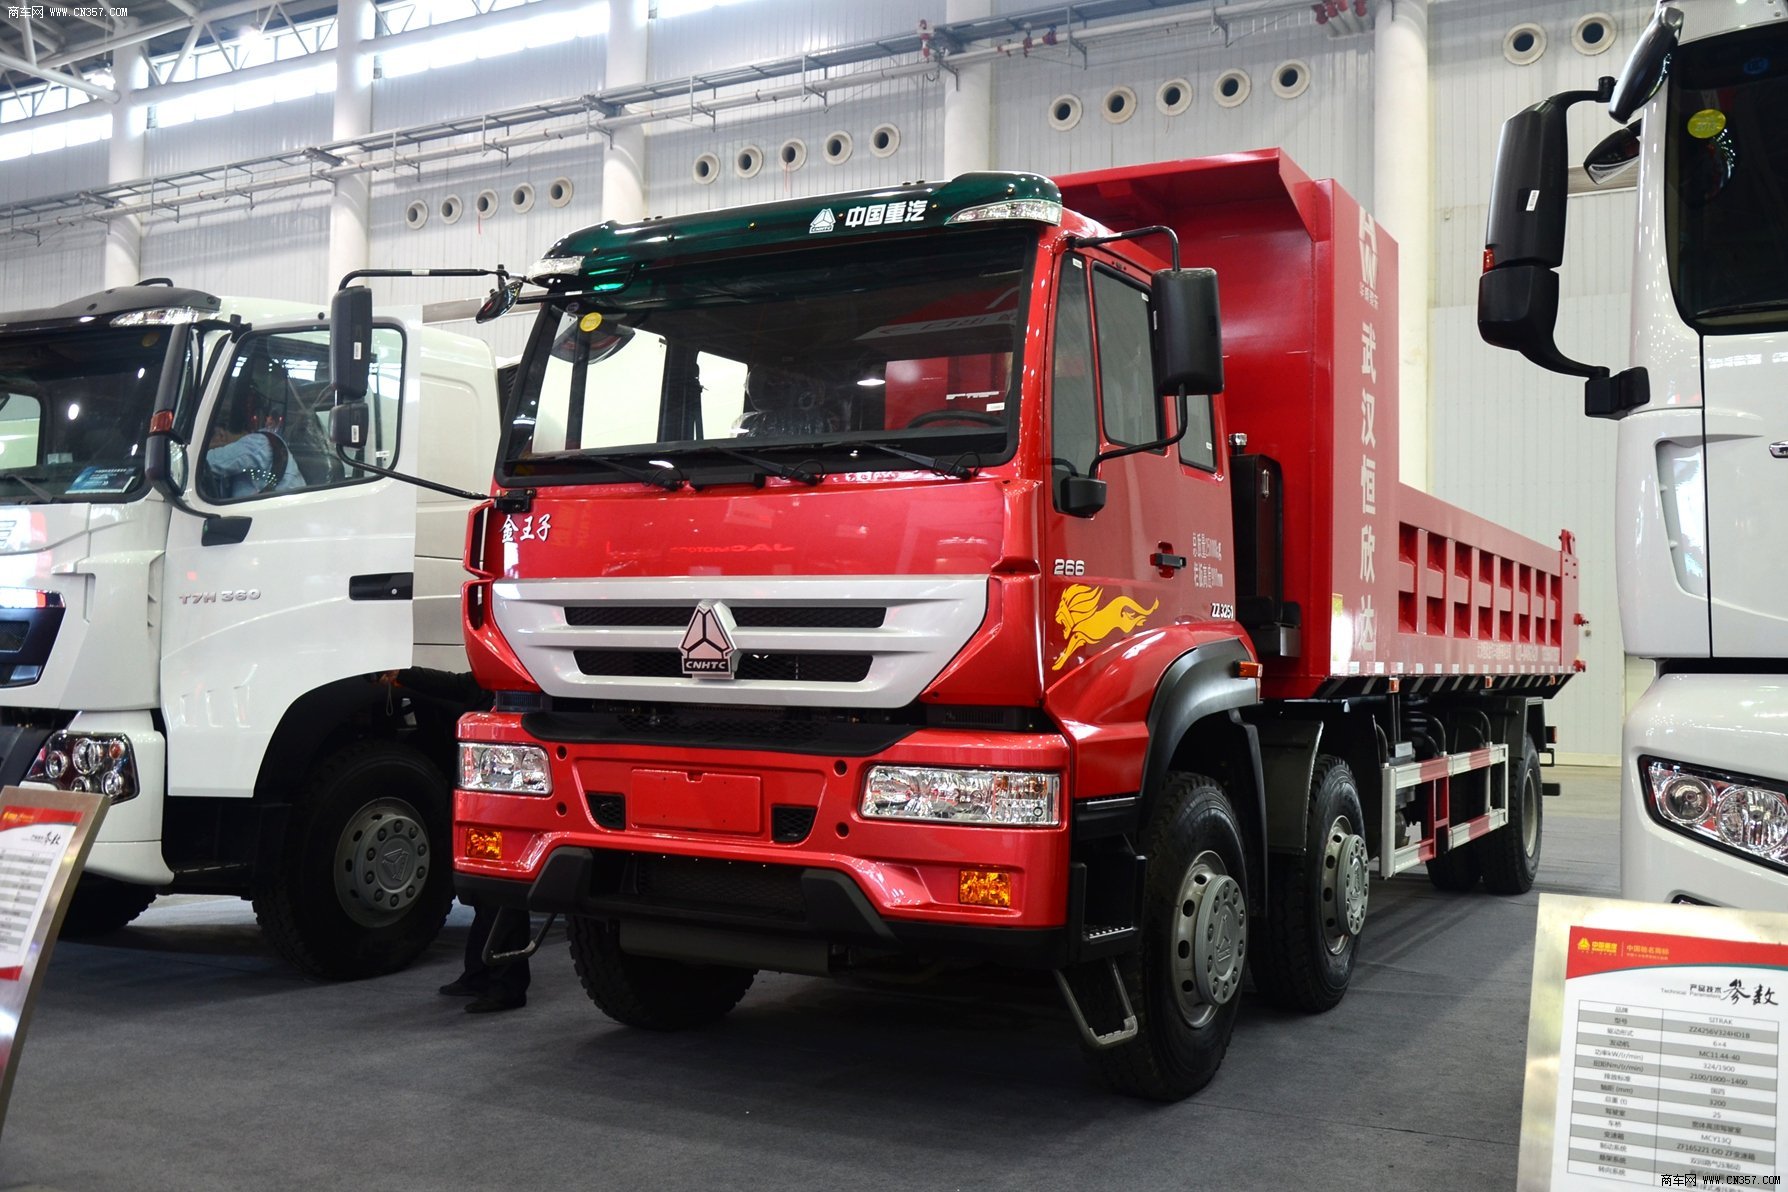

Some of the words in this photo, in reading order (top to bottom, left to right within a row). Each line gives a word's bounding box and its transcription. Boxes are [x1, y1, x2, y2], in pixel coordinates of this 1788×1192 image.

[845, 200, 928, 228] 中国重汽
[1360, 321, 1377, 651] 武汉恒欣达
[500, 513, 552, 543] 金王子
[1054, 558, 1085, 576] 266
[179, 592, 217, 605] T7H
[221, 589, 261, 602] 360
[685, 660, 727, 670] CNHTC
[1689, 983, 1722, 994] 产品技术
[1721, 978, 1779, 1006] 参数
